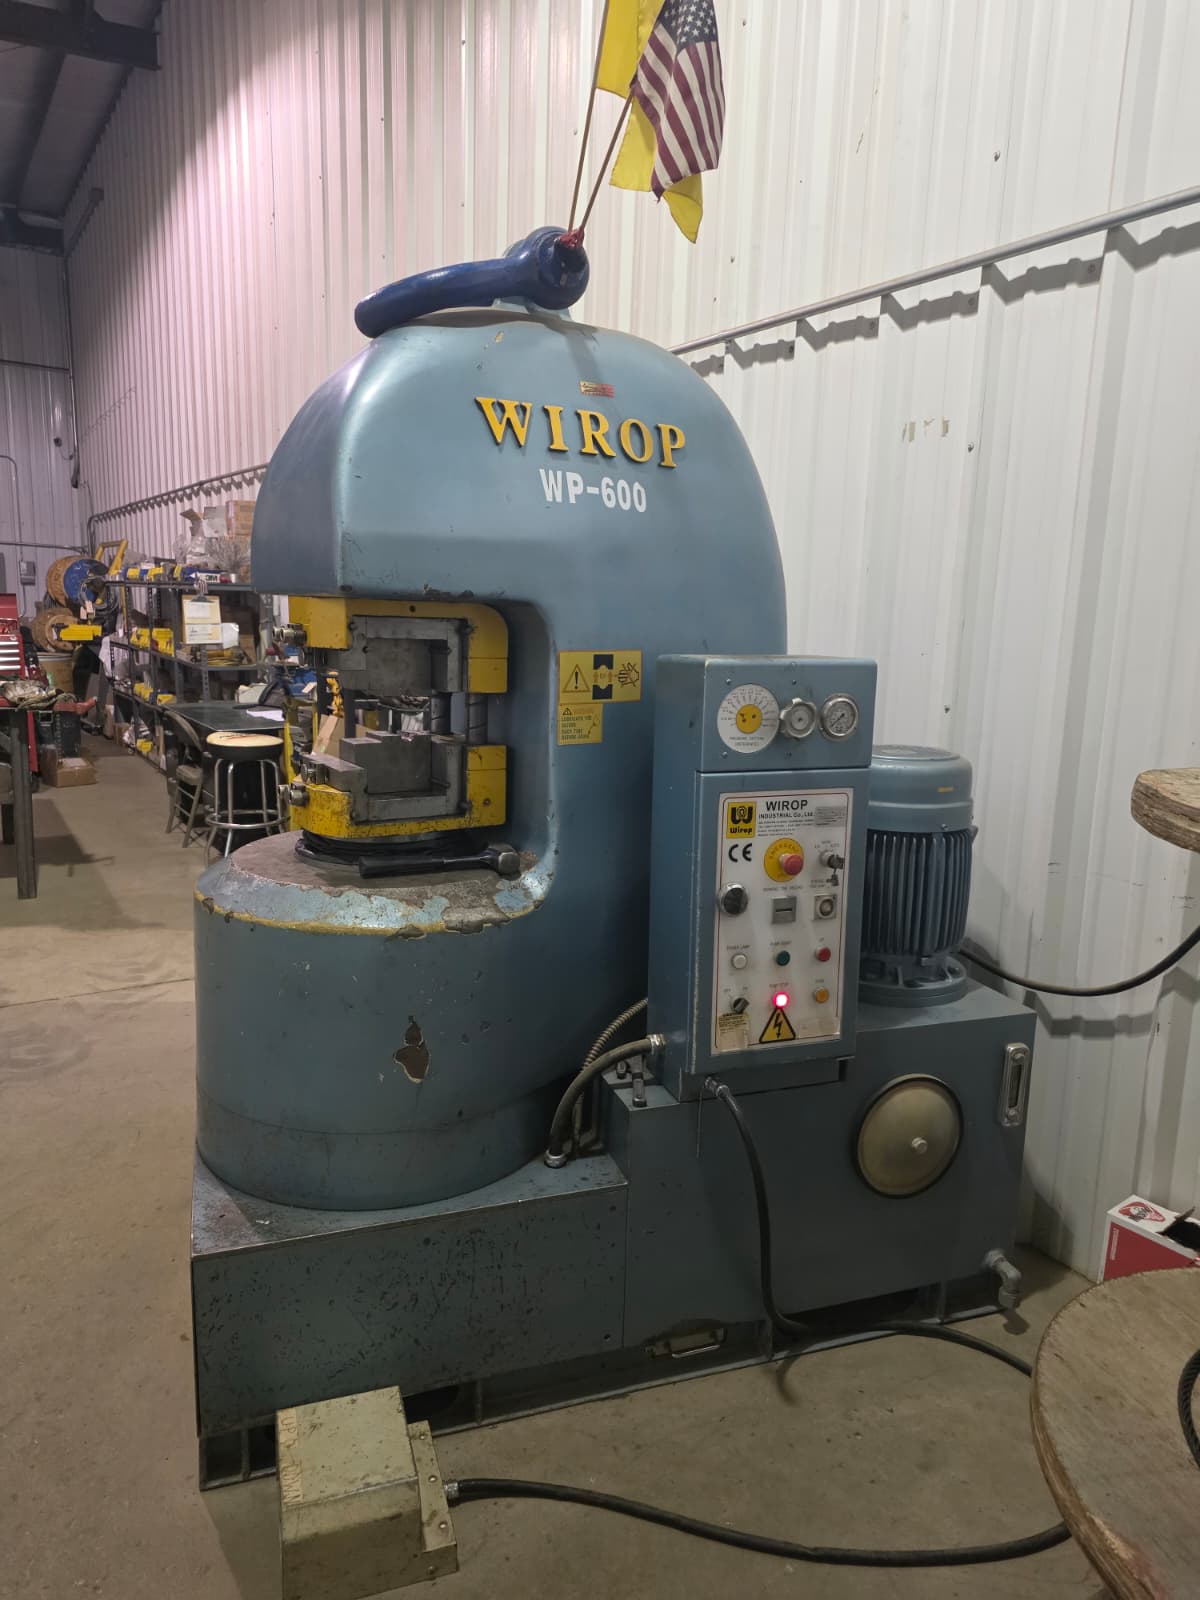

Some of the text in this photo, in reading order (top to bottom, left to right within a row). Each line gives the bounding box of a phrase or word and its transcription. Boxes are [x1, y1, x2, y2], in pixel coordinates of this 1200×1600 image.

[474, 396, 686, 468] WIROP
[538, 468, 647, 513] WP-600
[765, 799, 808, 812] WIROP
[728, 843, 753, 863] CE
